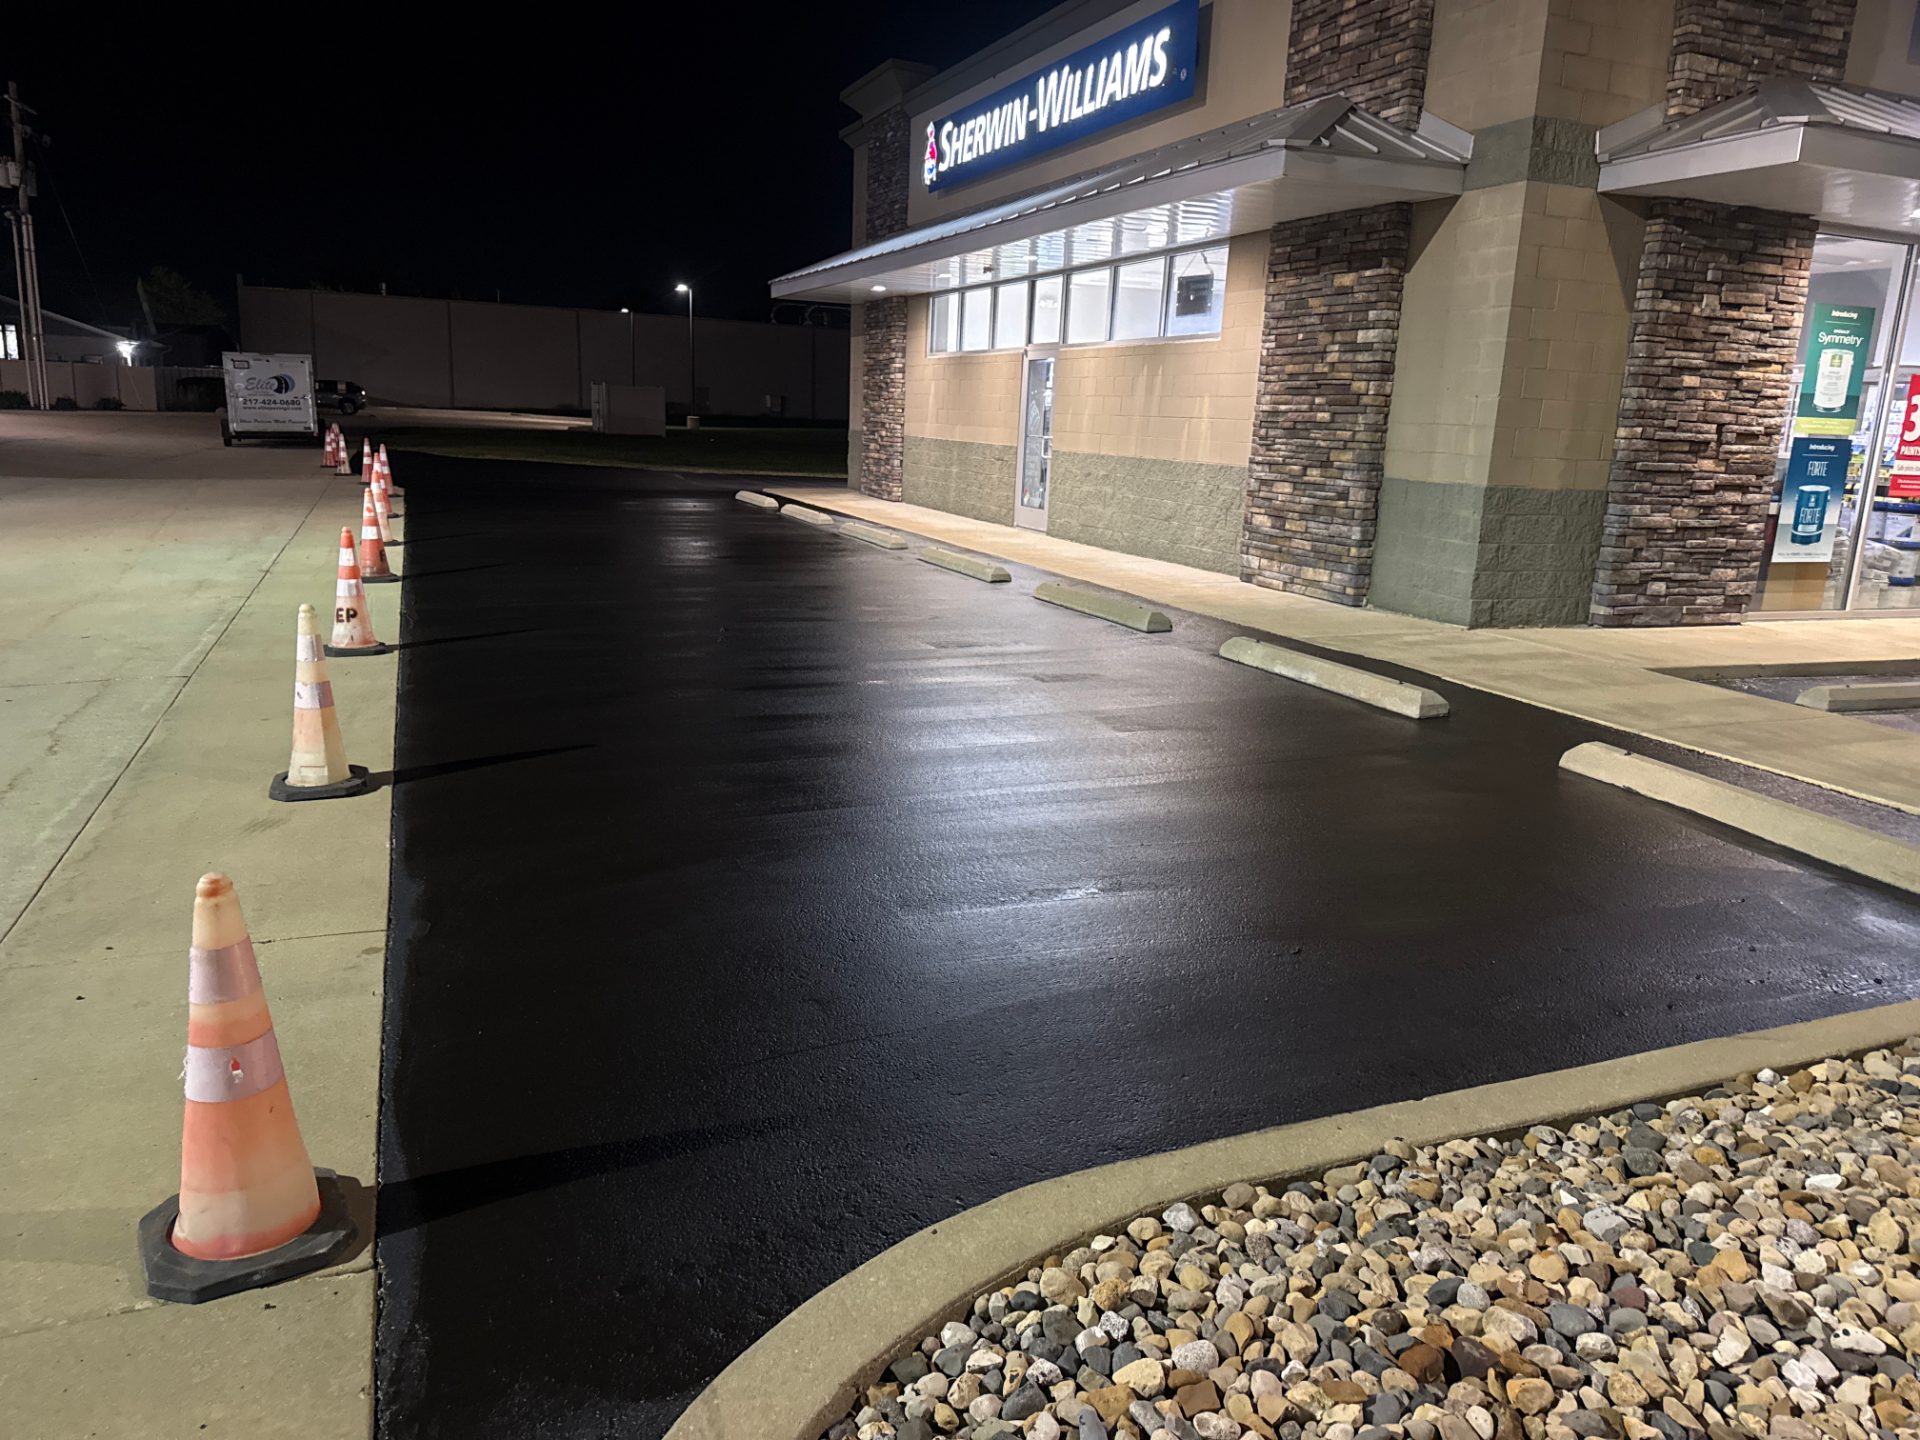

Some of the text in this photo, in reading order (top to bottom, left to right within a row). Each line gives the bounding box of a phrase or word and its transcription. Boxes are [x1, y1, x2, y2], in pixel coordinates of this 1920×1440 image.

[938, 26, 1171, 172] SHERWIN-WILLIAMS
[1831, 310, 1858, 319] Introducing
[1818, 331, 1863, 347] Symmetry
[246, 377, 276, 390] Elite
[1809, 444, 1835, 452] Introducing
[1807, 460, 1829, 477] FORTE
[336, 607, 358, 624] EP
